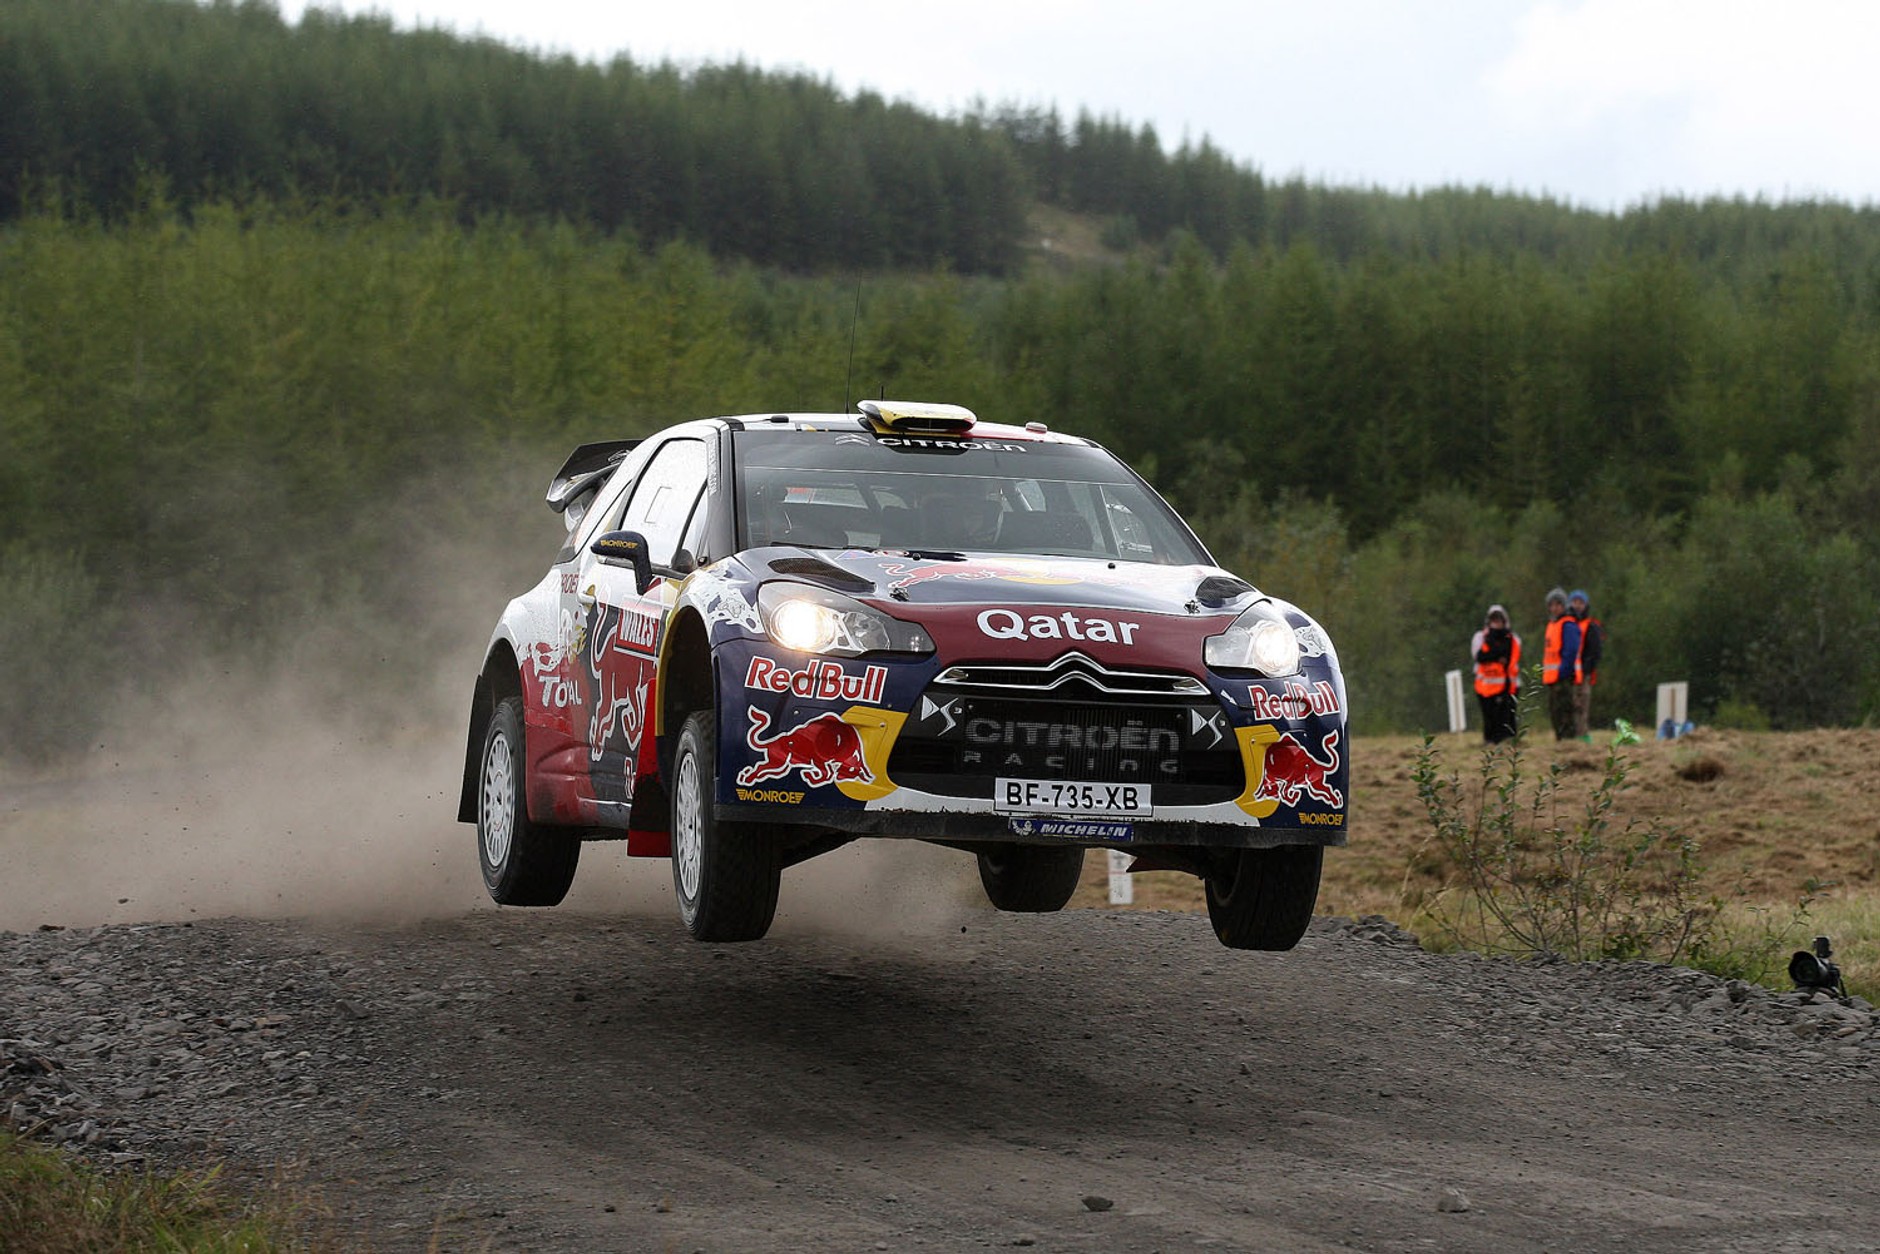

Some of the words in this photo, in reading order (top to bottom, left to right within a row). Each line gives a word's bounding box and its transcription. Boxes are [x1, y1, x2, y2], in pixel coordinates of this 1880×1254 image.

[620, 608, 656, 648] WALES
[976, 609, 1140, 646] Qatar
[742, 790, 799, 803] MONROE
[1006, 782, 1139, 810] BF-735-XB
[1301, 812, 1342, 826] MONROE
[1040, 823, 1128, 837] MICHELIN
